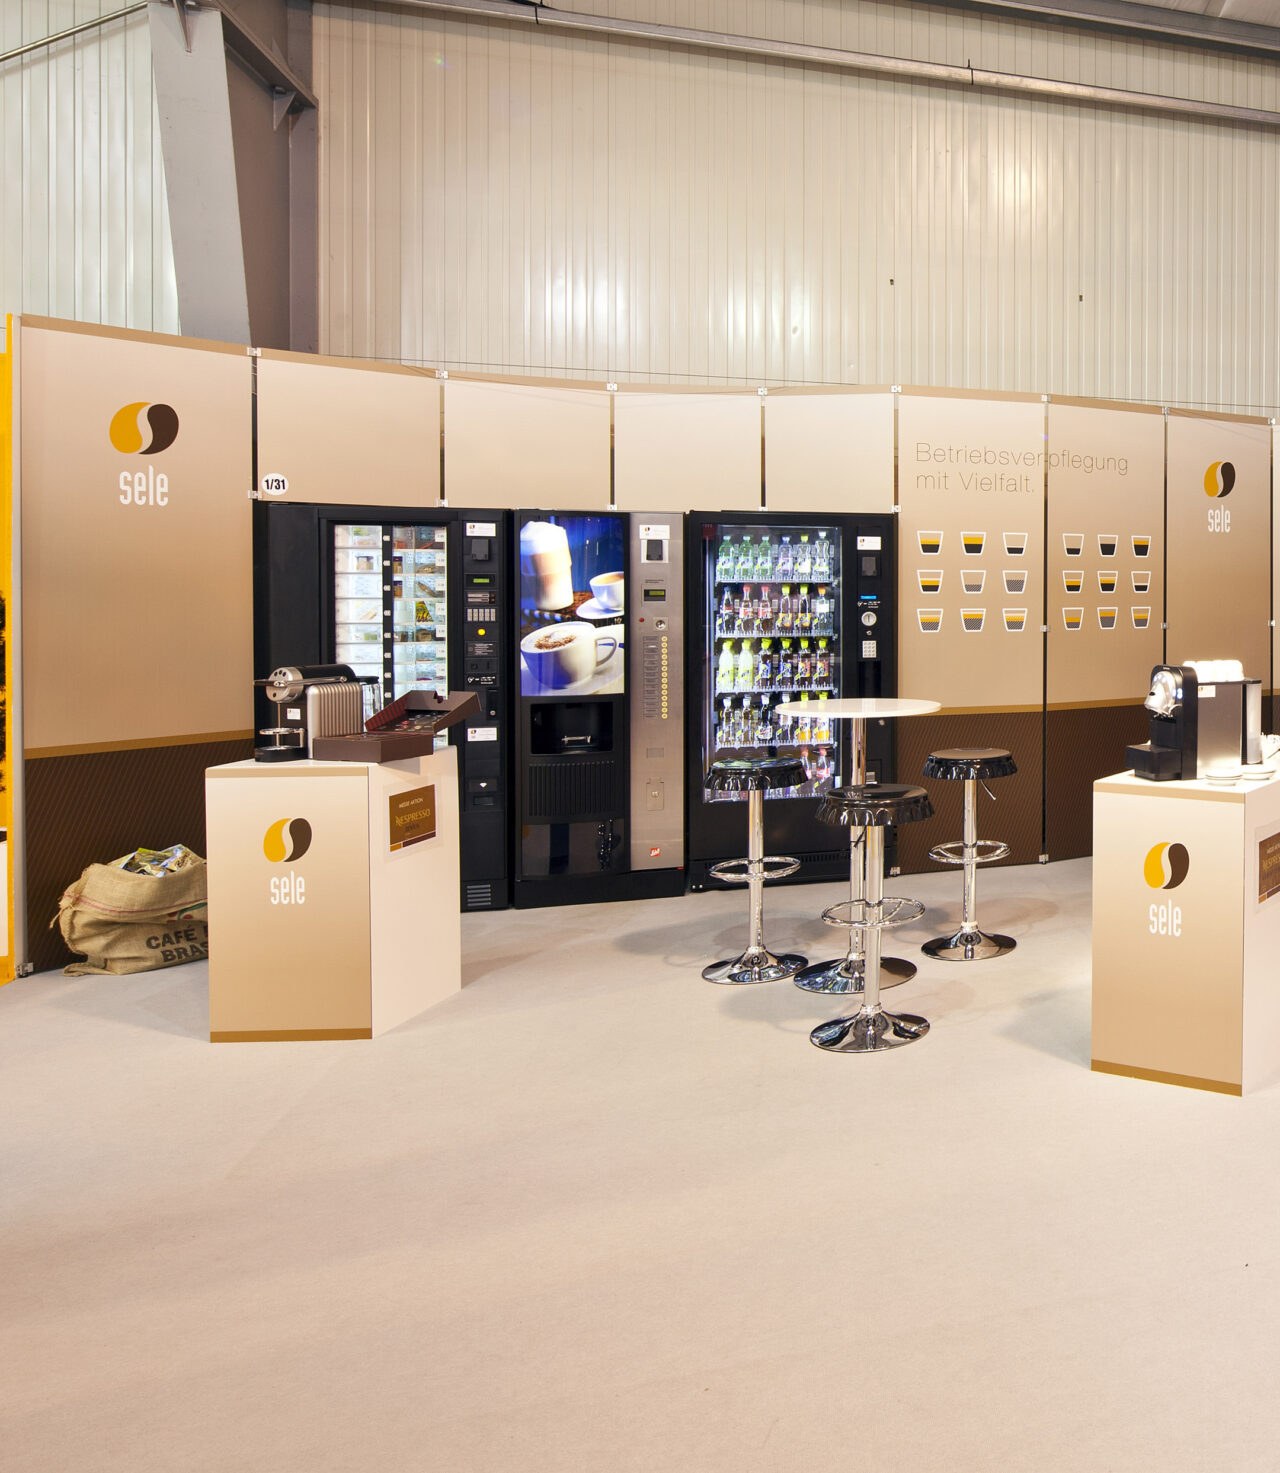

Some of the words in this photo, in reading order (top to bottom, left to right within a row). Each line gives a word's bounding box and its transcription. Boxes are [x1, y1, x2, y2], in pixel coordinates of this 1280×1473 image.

[915, 442, 1129, 476] Betriebsverpflegung
[119, 465, 169, 506] sele
[264, 479, 286, 490] 1/31
[916, 471, 949, 490] mit
[959, 471, 1035, 493] Vielfalt.
[1208, 504, 1231, 533] sele
[395, 808, 431, 827] NESPRESSO
[270, 870, 306, 905] sele
[1149, 899, 1182, 937] sele
[146, 924, 198, 950] CAFÉ
